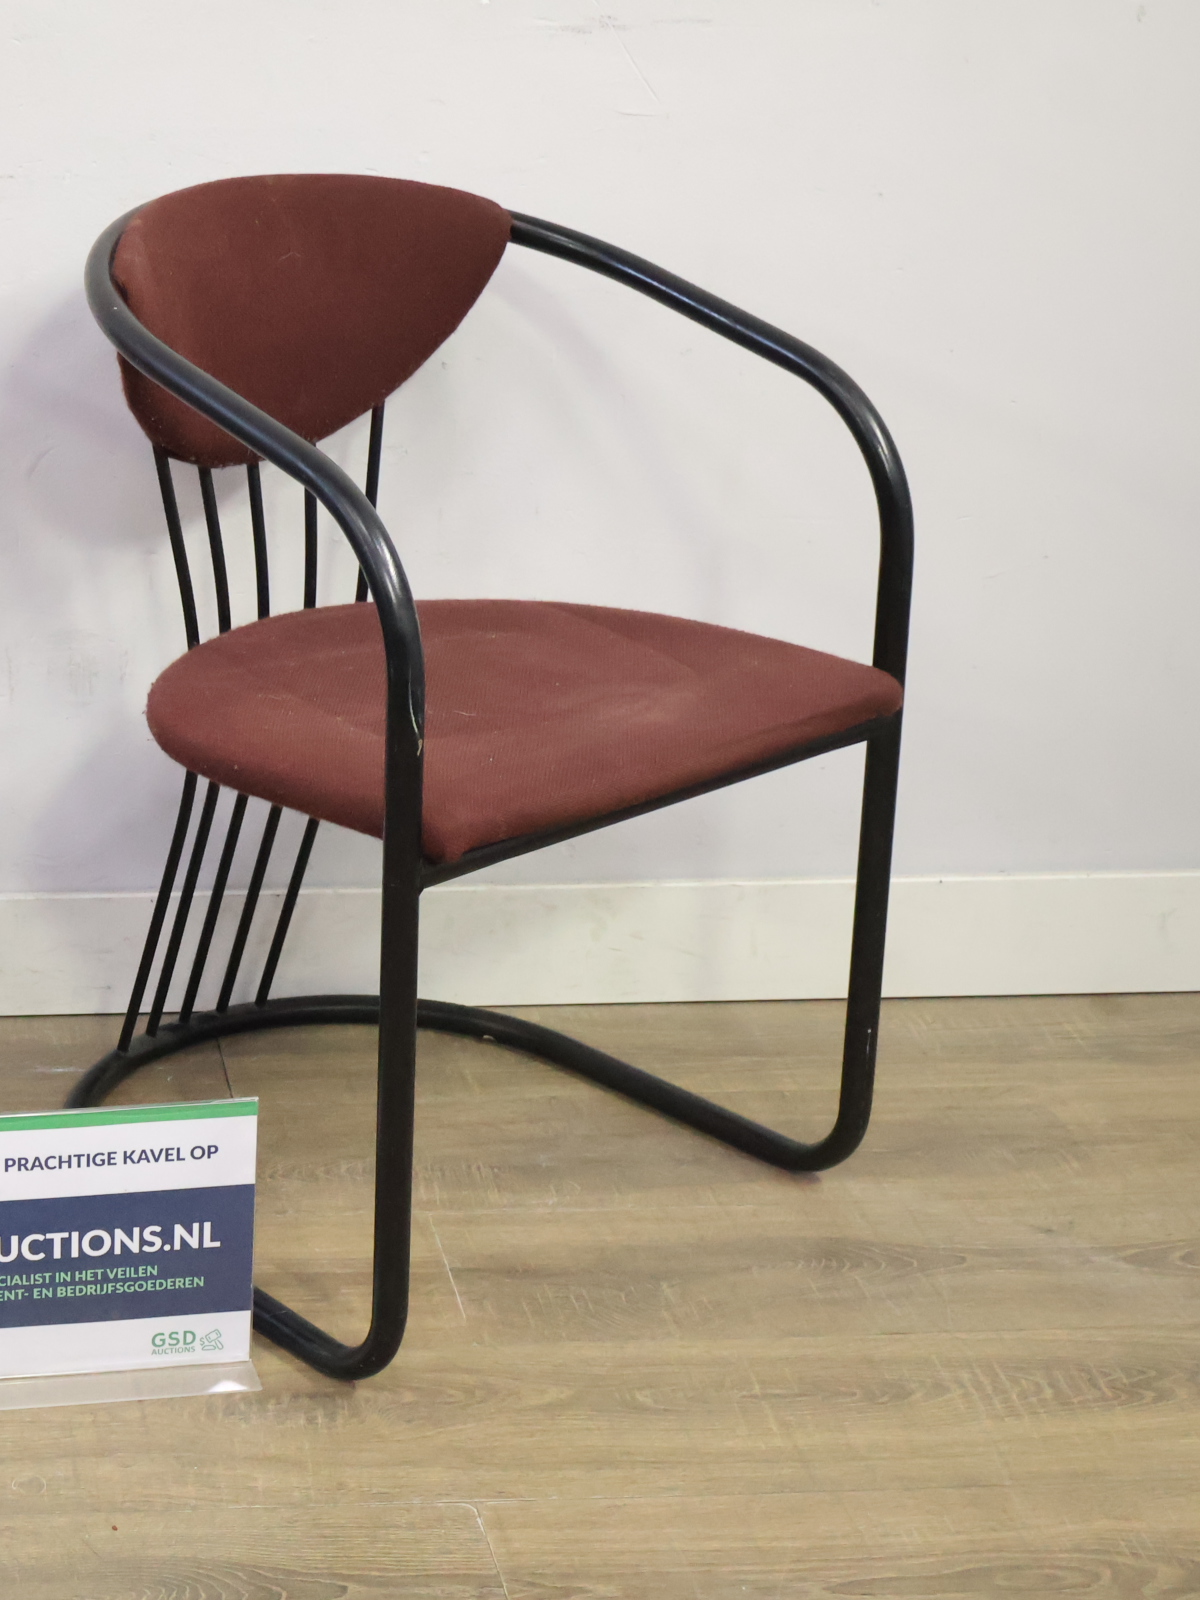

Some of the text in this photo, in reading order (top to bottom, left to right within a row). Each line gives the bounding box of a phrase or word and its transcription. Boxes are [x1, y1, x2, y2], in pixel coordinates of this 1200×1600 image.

[4, 1151, 117, 1173] PRACHTIGE
[123, 1147, 185, 1165] KAVEL
[190, 1144, 219, 1161] OP
[55, 1271, 71, 1283] IN
[75, 1268, 104, 1282] HET
[106, 1265, 158, 1280] VEILEN
[33, 1286, 53, 1299] EN
[57, 1276, 204, 1298] BEDRIJFSGOEDEREN
[151, 1330, 197, 1348] GSD
[151, 1345, 196, 1356] AUCTIONS
